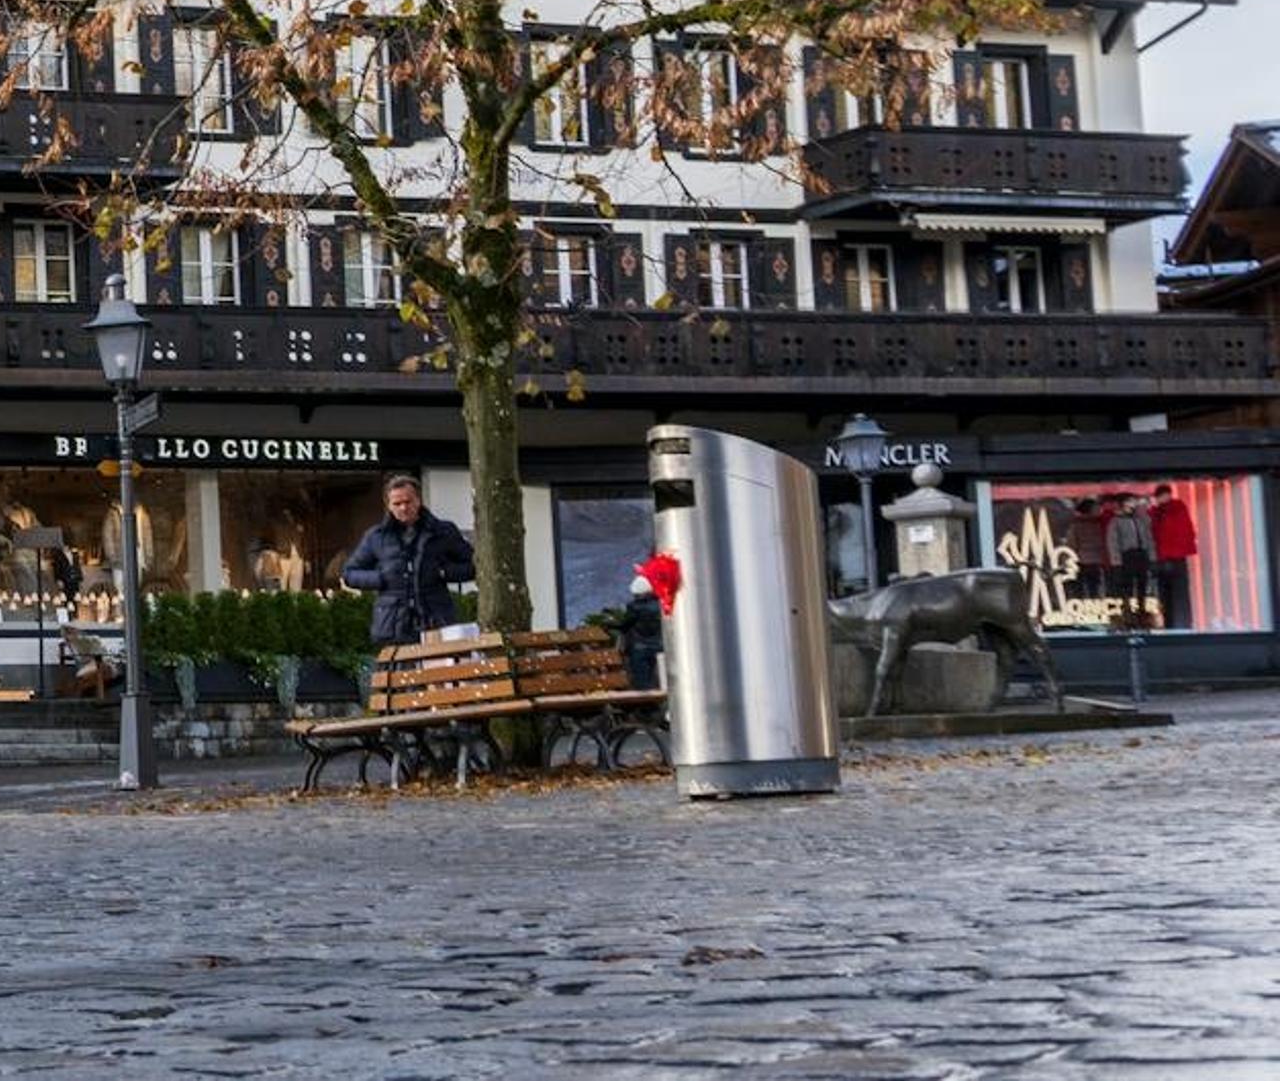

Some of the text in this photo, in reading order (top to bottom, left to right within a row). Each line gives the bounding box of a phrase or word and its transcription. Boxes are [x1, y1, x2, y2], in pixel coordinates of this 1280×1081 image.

[54, 436, 379, 461] BRLLO CUCINELLI
[824, 443, 952, 467] MNCLER
